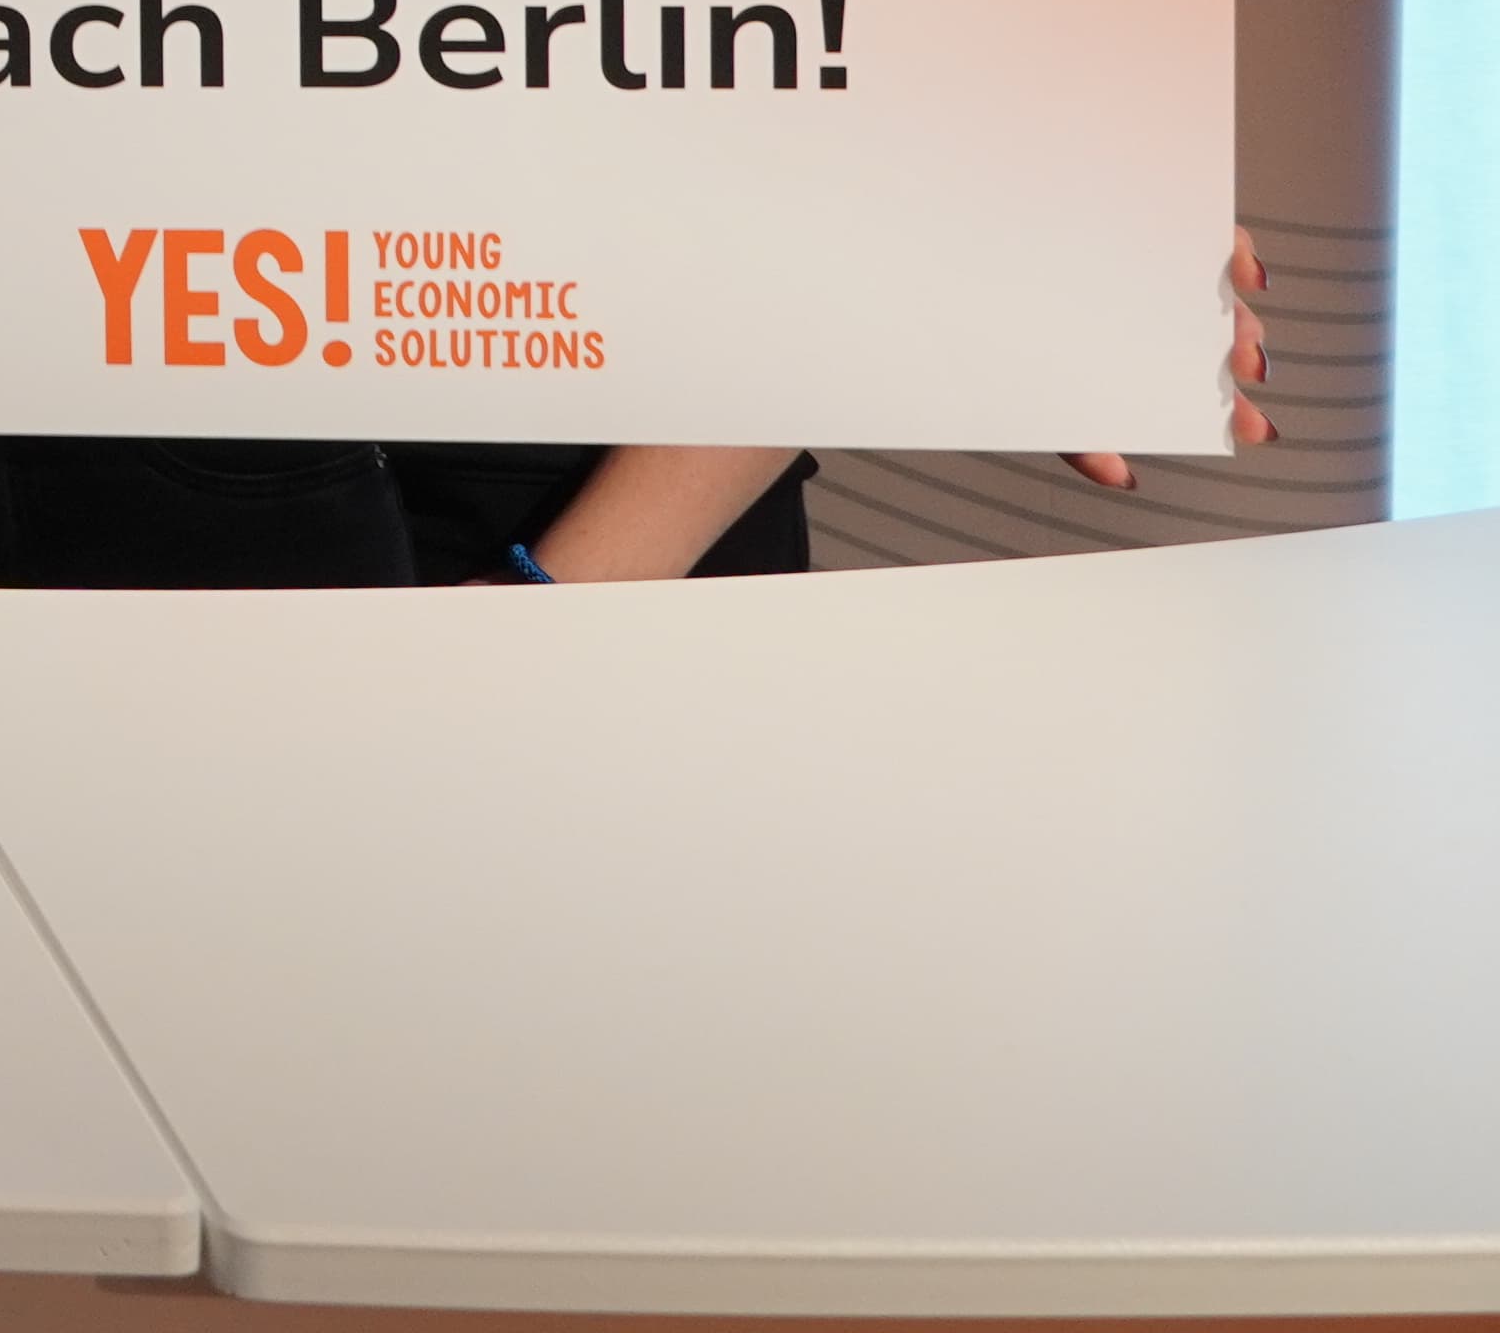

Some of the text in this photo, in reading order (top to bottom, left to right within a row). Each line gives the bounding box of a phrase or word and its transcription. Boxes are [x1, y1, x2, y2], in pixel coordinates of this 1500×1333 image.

[372, 231, 501, 270] YOUNG
[78, 228, 353, 367] YES!
[374, 280, 578, 319] ECONOMIC
[374, 329, 605, 369] SOLUTIONS
